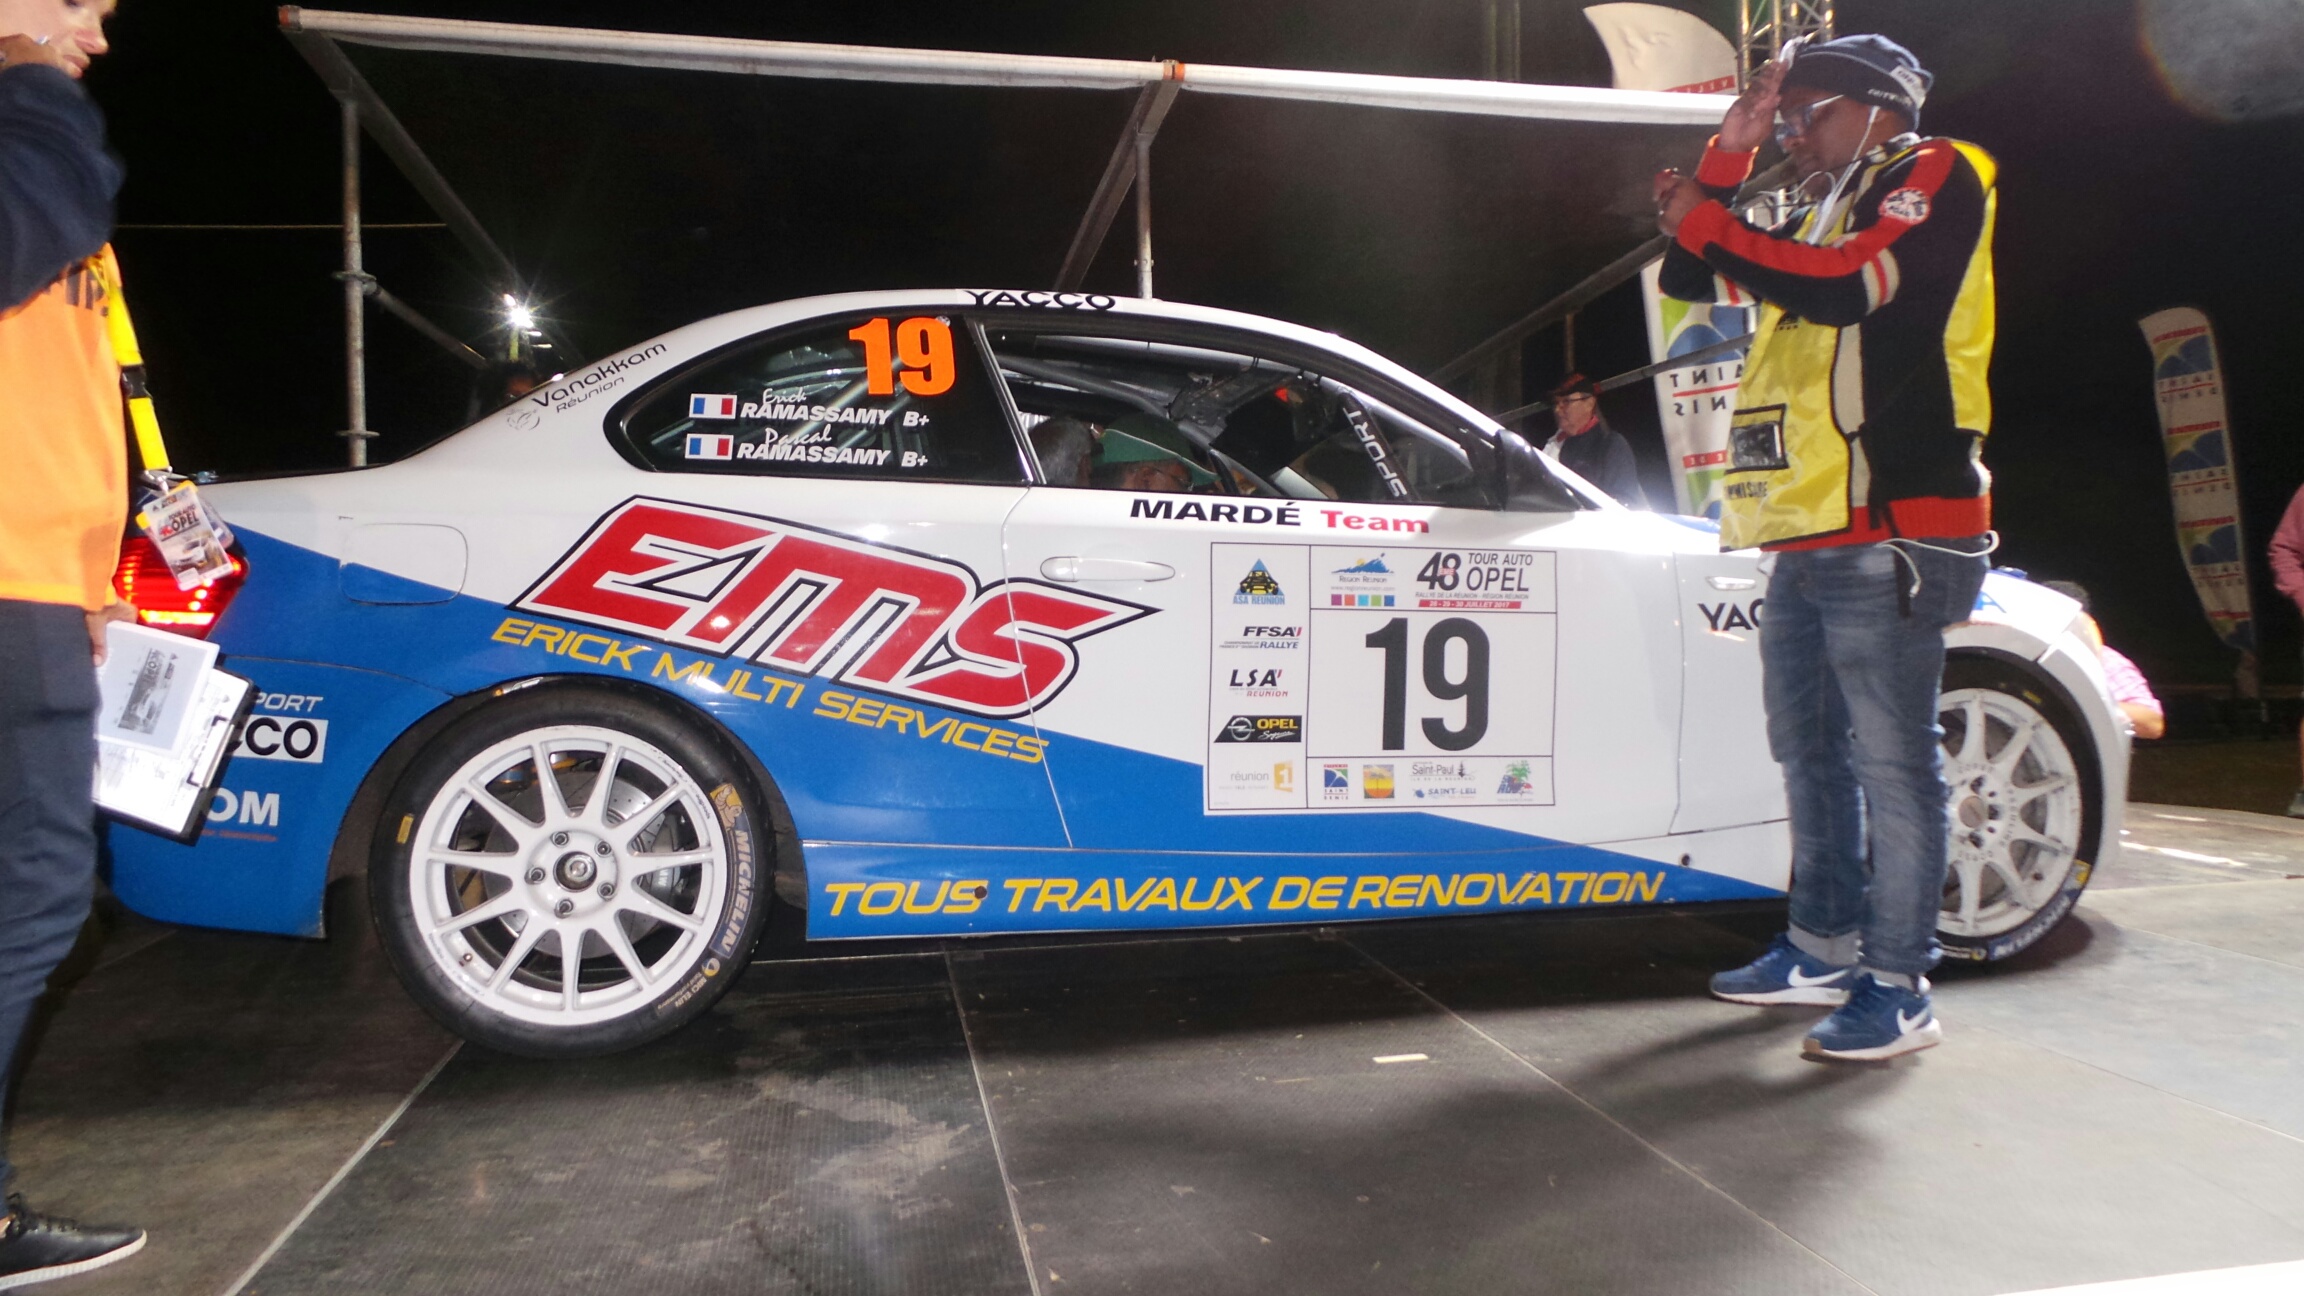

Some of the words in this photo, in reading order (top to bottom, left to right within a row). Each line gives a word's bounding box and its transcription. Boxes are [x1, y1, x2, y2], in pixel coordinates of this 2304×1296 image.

[965, 290, 1116, 311] YACCO
[849, 317, 956, 396] 19
[531, 343, 667, 408] Vanakkam
[556, 376, 625, 414] Réunion
[763, 387, 807, 404] Erick
[740, 402, 893, 425] RAMASSAMY
[902, 410, 930, 427] B+
[764, 423, 832, 448] Pascal
[737, 442, 891, 466] RAMASSAMY
[901, 451, 929, 468] B+
[1342, 406, 1408, 498] SPORT
[171, 510, 200, 533] OPEL
[1130, 498, 1301, 527] MARDÉ
[1320, 509, 1430, 533] Team
[1416, 551, 1462, 591] 48
[1468, 552, 1499, 565] TOUR
[1502, 554, 1533, 566] AUTO
[1466, 566, 1530, 592] OPEL
[510, 496, 1160, 718] EMS
[1233, 595, 1249, 605] ASA
[1415, 591, 1436, 599] RALLYE
[1697, 598, 1765, 631] YAC
[1243, 626, 1296, 637] FFSA
[1259, 641, 1299, 649] RALLYE
[491, 616, 648, 671] ERICK
[651, 652, 806, 709] MULTI
[813, 691, 1050, 764] SERVICES
[1365, 616, 1491, 751] 19
[256, 692, 324, 713] PORT
[1256, 718, 1299, 729] OPEL
[1230, 771, 1269, 781] réunion
[1412, 763, 1455, 775] Saint-Paul
[206, 787, 280, 827] OM
[722, 829, 755, 953] MICHELIN
[825, 880, 989, 917] TOUS
[1003, 876, 1264, 912] TRAVAUX
[1268, 876, 1348, 910] DE
[1348, 871, 1666, 909] RENOVATION
[673, 975, 709, 1008] MICELIN
